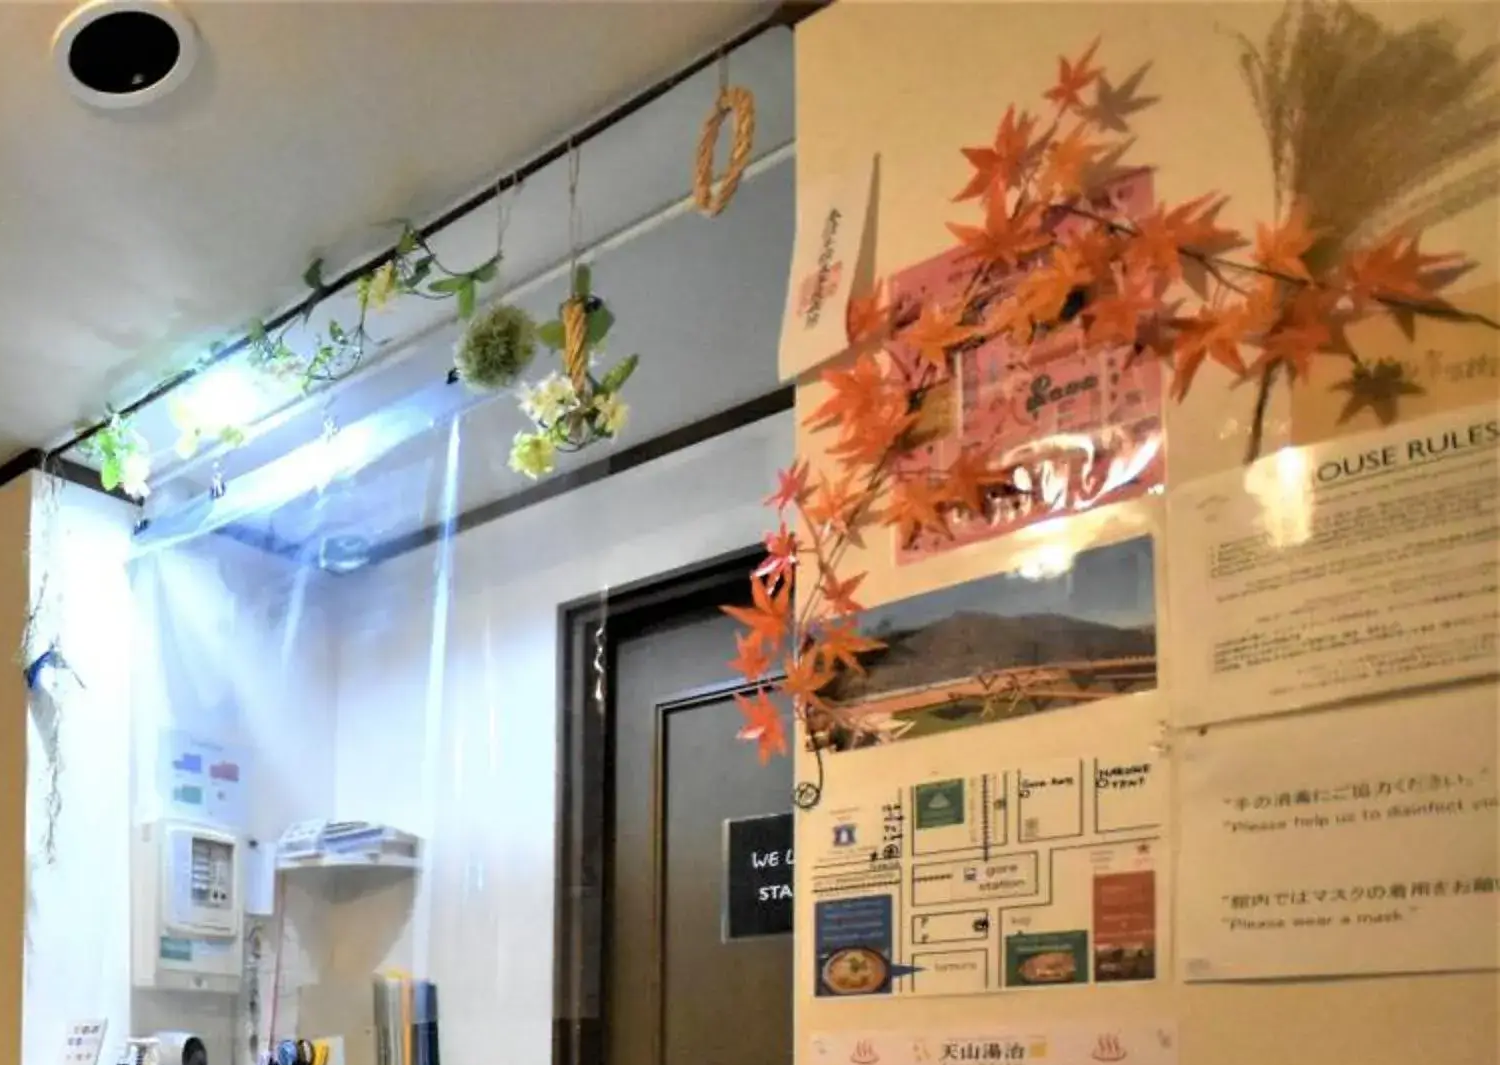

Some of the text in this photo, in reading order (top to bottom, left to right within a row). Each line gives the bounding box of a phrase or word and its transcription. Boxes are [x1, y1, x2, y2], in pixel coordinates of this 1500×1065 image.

[1312, 420, 1500, 483] OUSE RULES
[1293, 815, 1330, 829] help
[751, 850, 779, 868] WE
[940, 1041, 1026, 1061] 天山湯治
